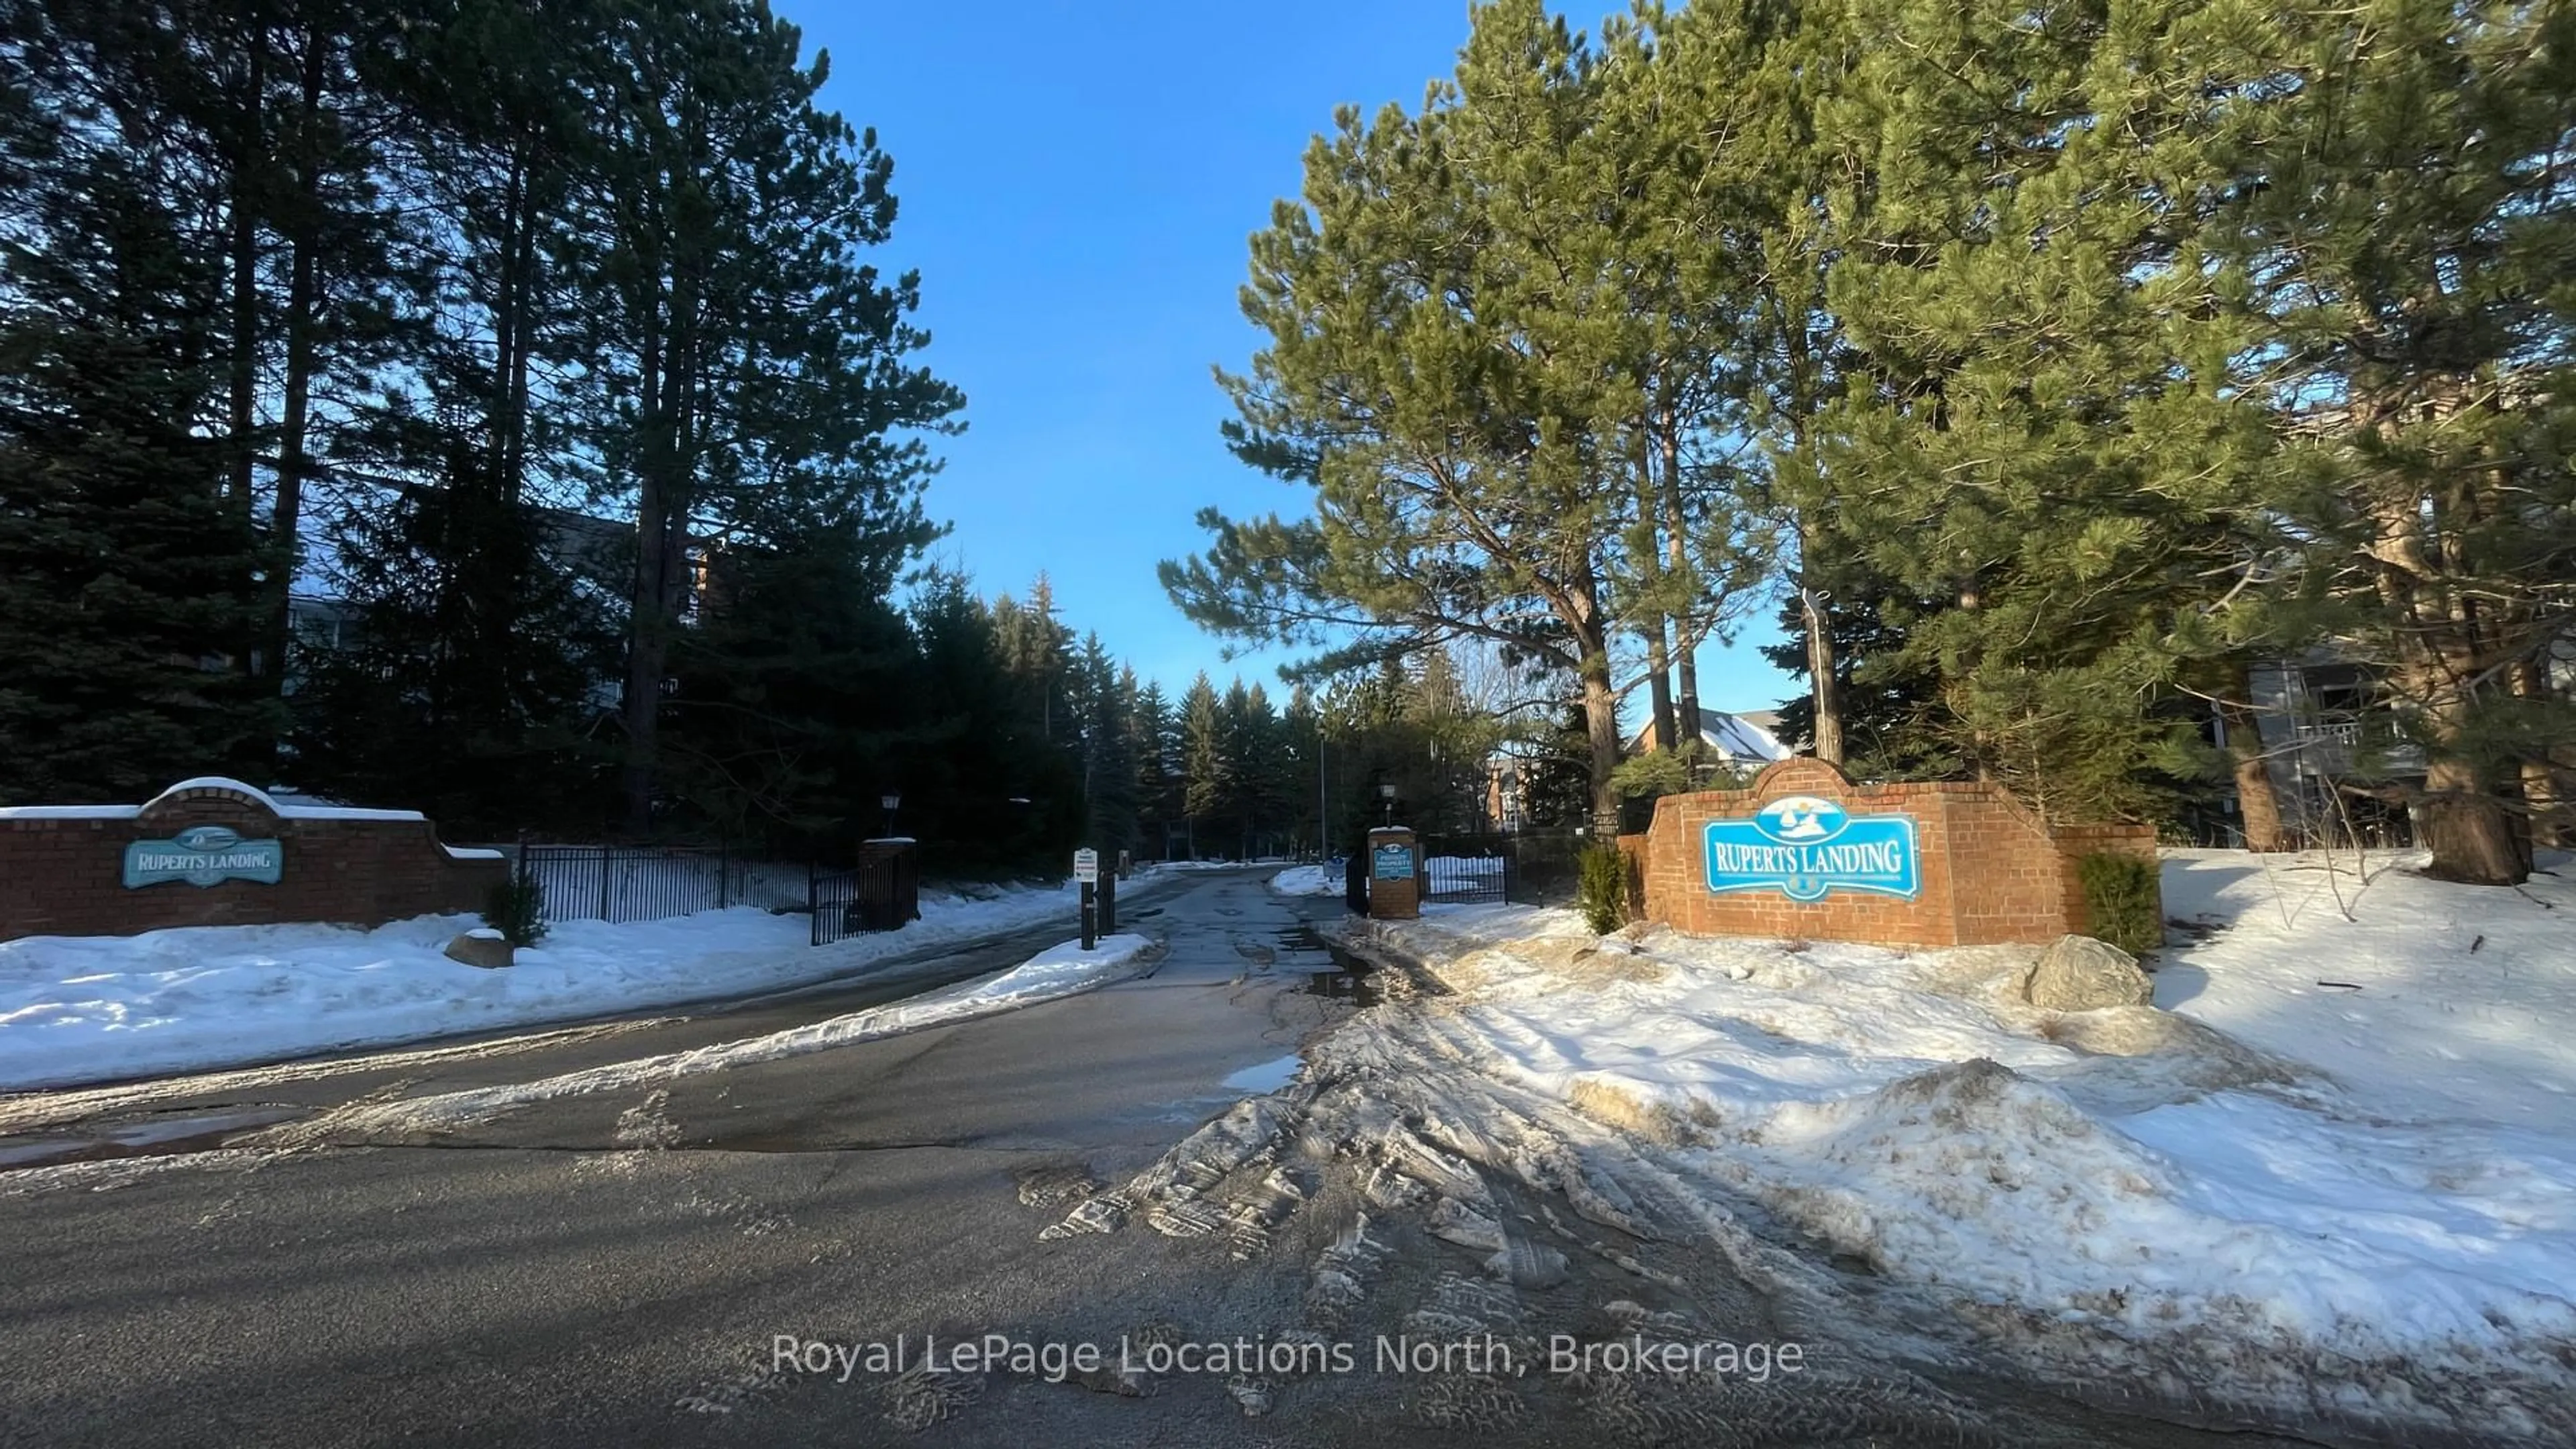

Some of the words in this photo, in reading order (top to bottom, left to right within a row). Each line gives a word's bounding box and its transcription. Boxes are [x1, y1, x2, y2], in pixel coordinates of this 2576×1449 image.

[139, 853, 205, 870] RUPERTS
[209, 852, 270, 869] LANDING
[1715, 841, 1798, 873] RUPERTS
[1800, 840, 1901, 873] LANDING
